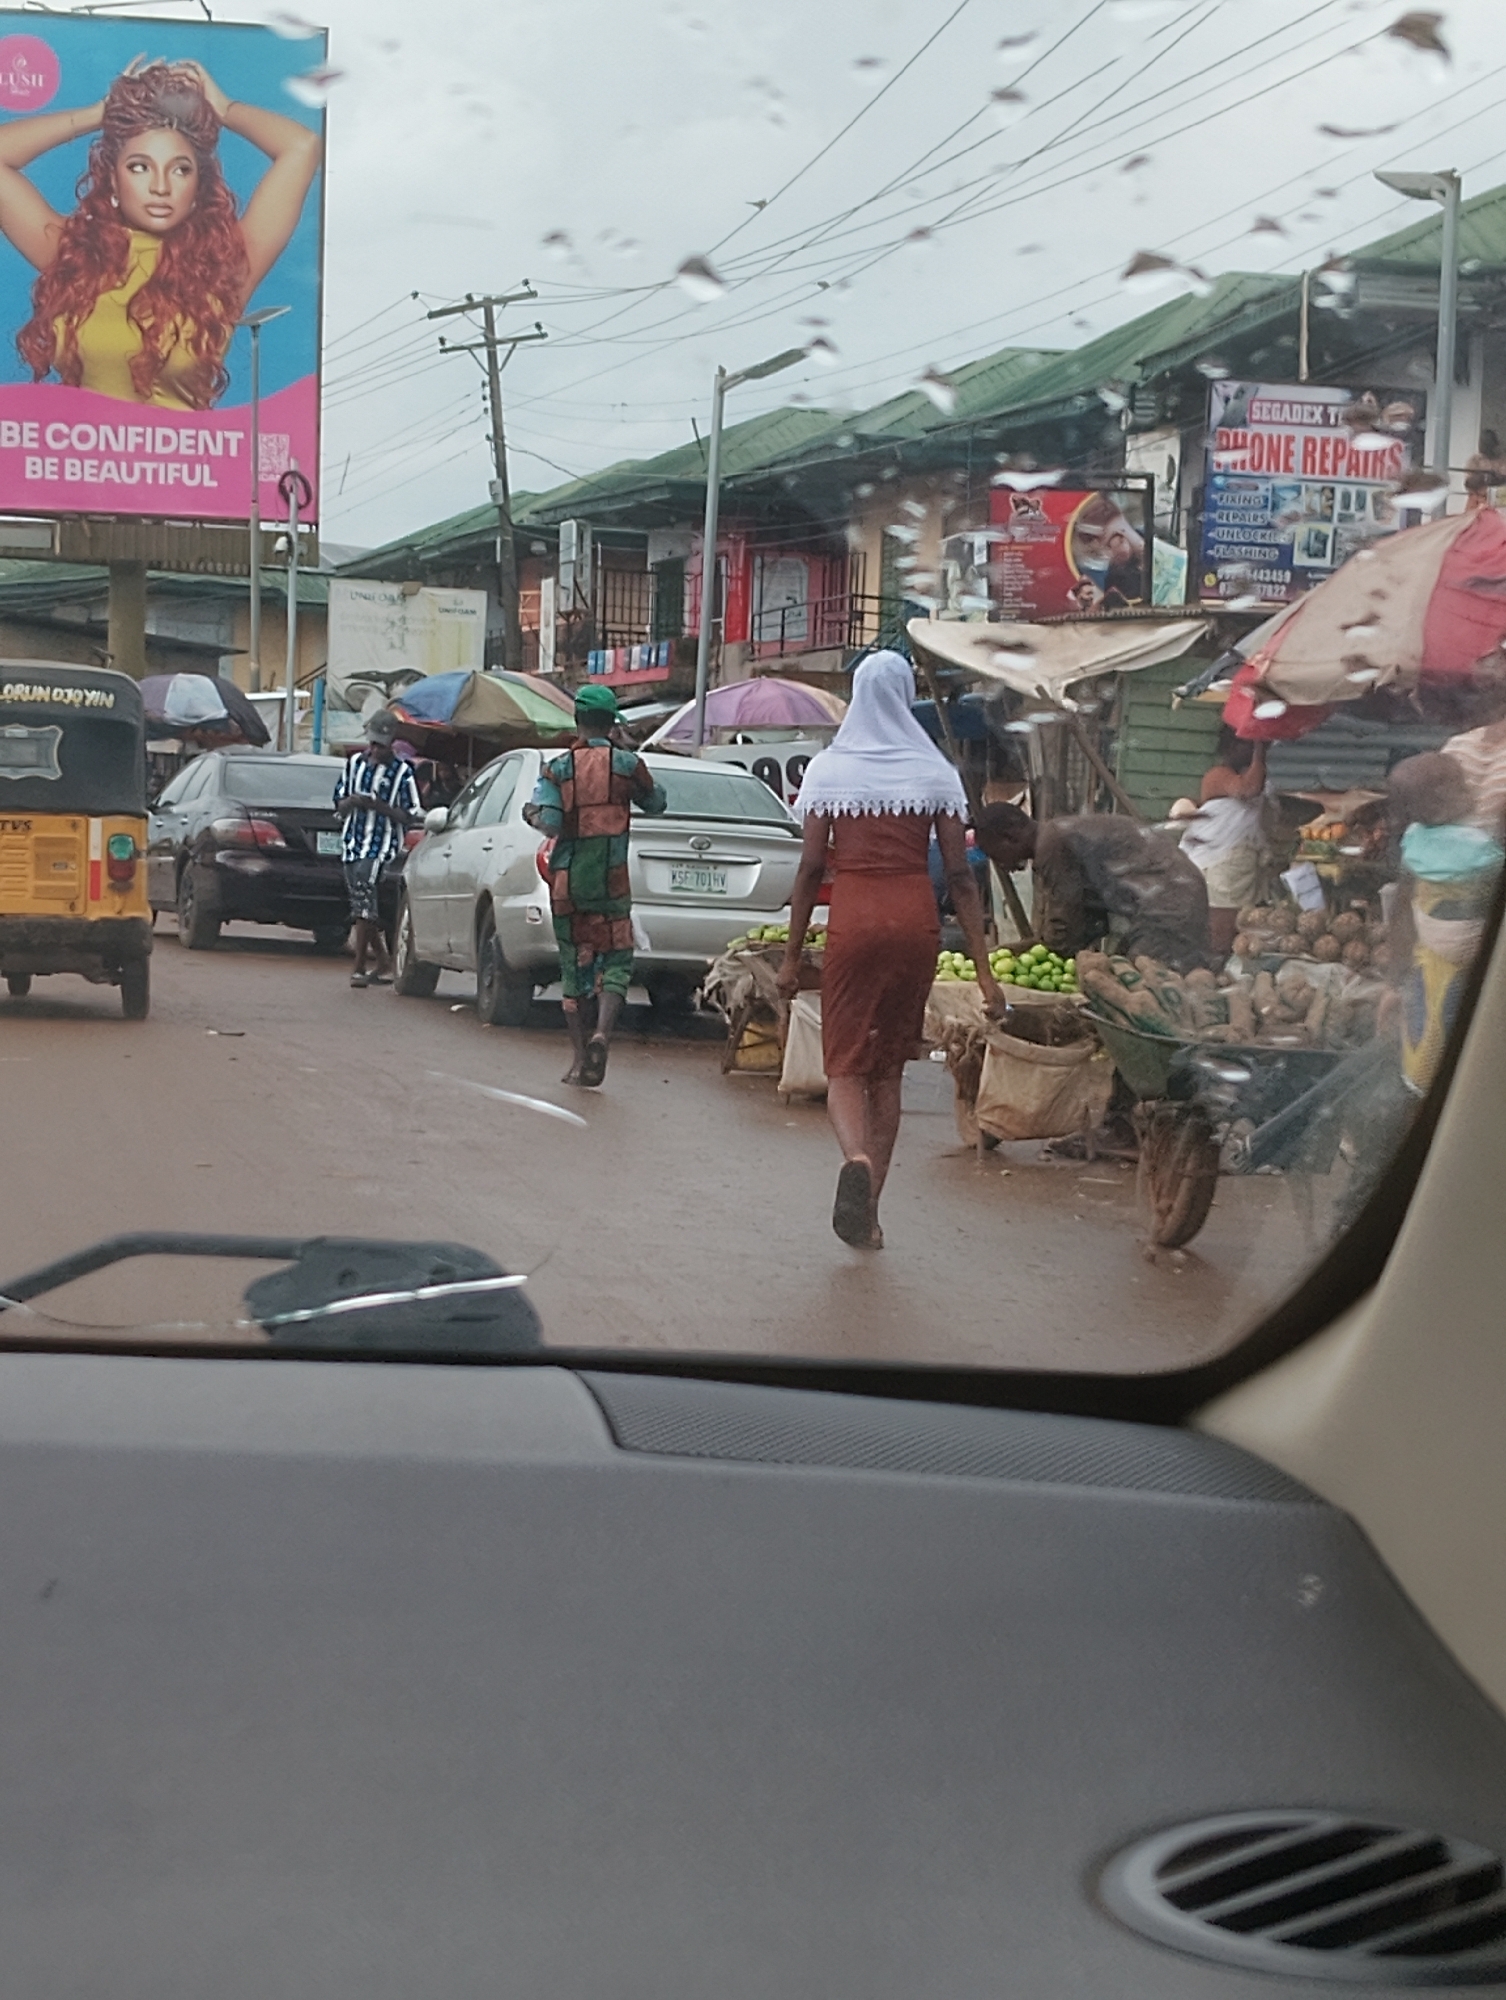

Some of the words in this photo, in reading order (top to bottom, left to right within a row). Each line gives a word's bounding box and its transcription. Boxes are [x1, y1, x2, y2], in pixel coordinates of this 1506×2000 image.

[1251, 401, 1324, 425] SEGADEX
[0, 420, 40, 449] BE
[44, 422, 245, 458] CONFIDENT
[1212, 427, 1296, 475] PHONE
[24, 455, 59, 481] BE
[64, 457, 219, 488] BEAUTIFUL
[1217, 492, 1263, 506] FIXING
[1215, 510, 1268, 525] REPAIRS
[1214, 545, 1279, 559] FLASHING
[0, 819, 33, 831] TVS
